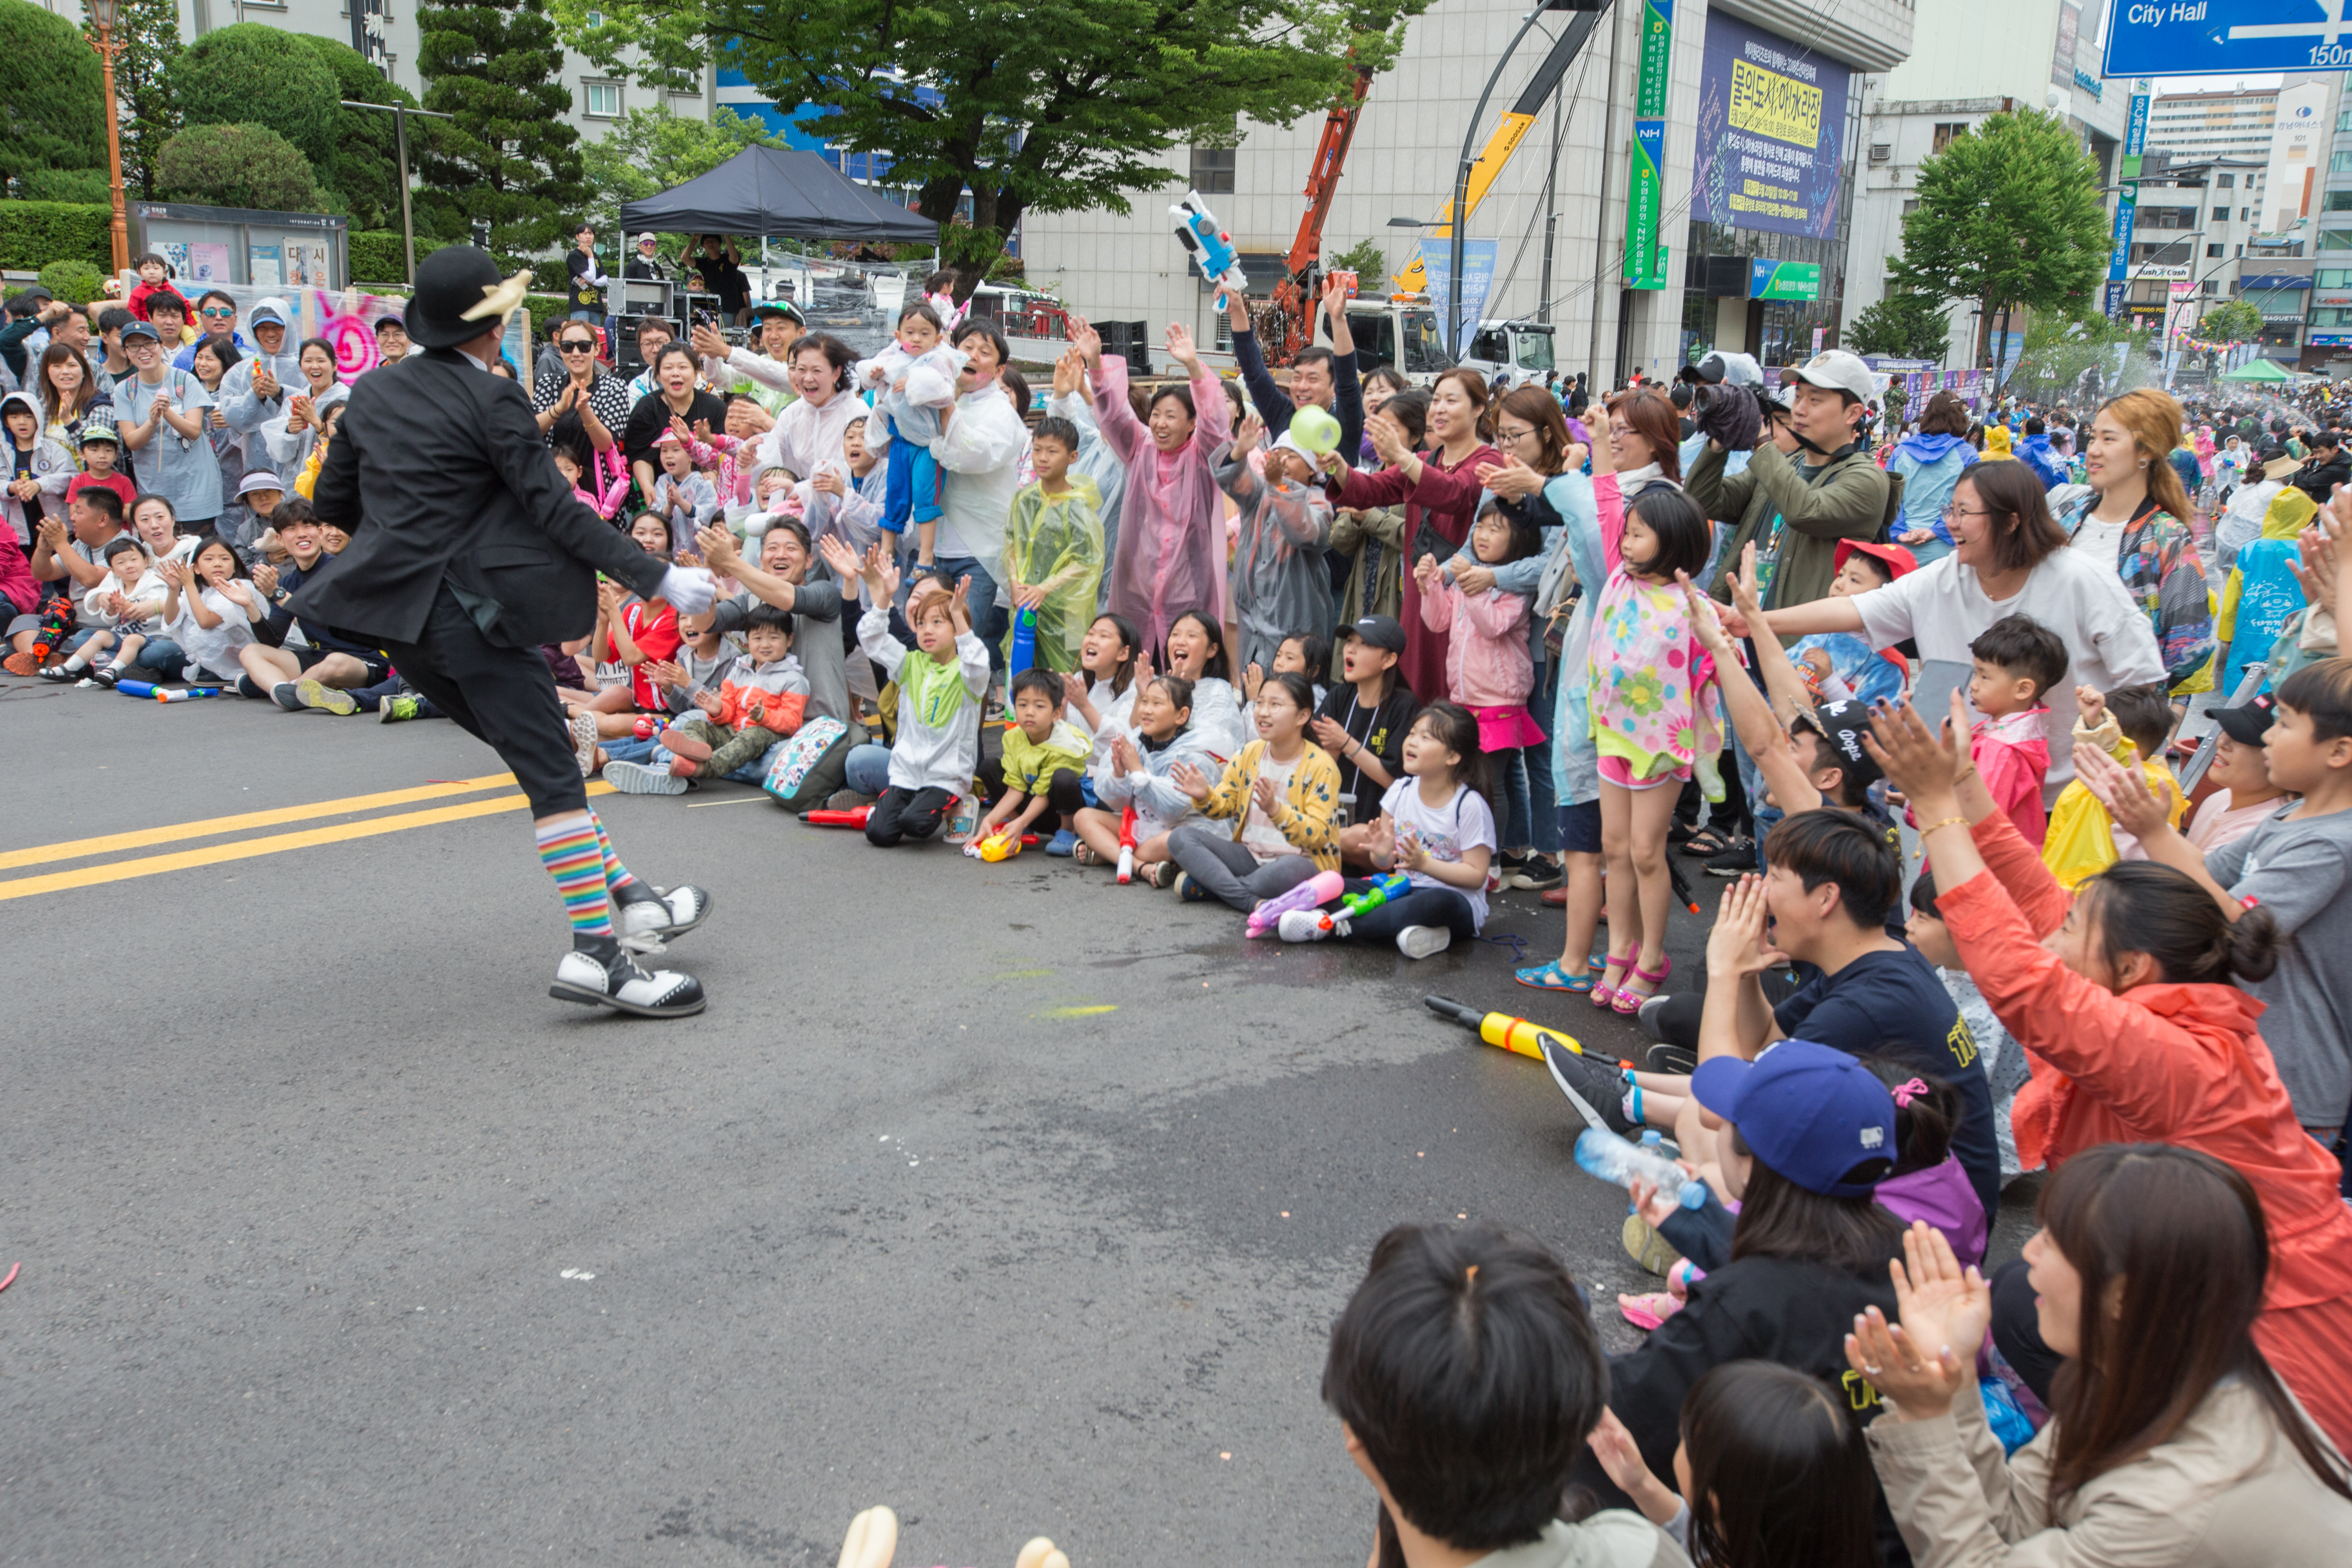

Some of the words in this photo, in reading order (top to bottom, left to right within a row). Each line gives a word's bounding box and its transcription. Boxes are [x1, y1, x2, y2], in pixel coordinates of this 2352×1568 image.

[2128, 4, 2166, 27] City
[2170, 1, 2207, 22] Hall
[1730, 107, 1738, 124] 5월
[1738, 109, 1748, 127] 20일
[1508, 121, 1525, 145] SOOSAN
[1640, 129, 1660, 138] NH
[1754, 265, 1765, 278] NH
[2251, 619, 2283, 627] Funn
[1838, 729, 1862, 762] Dope
